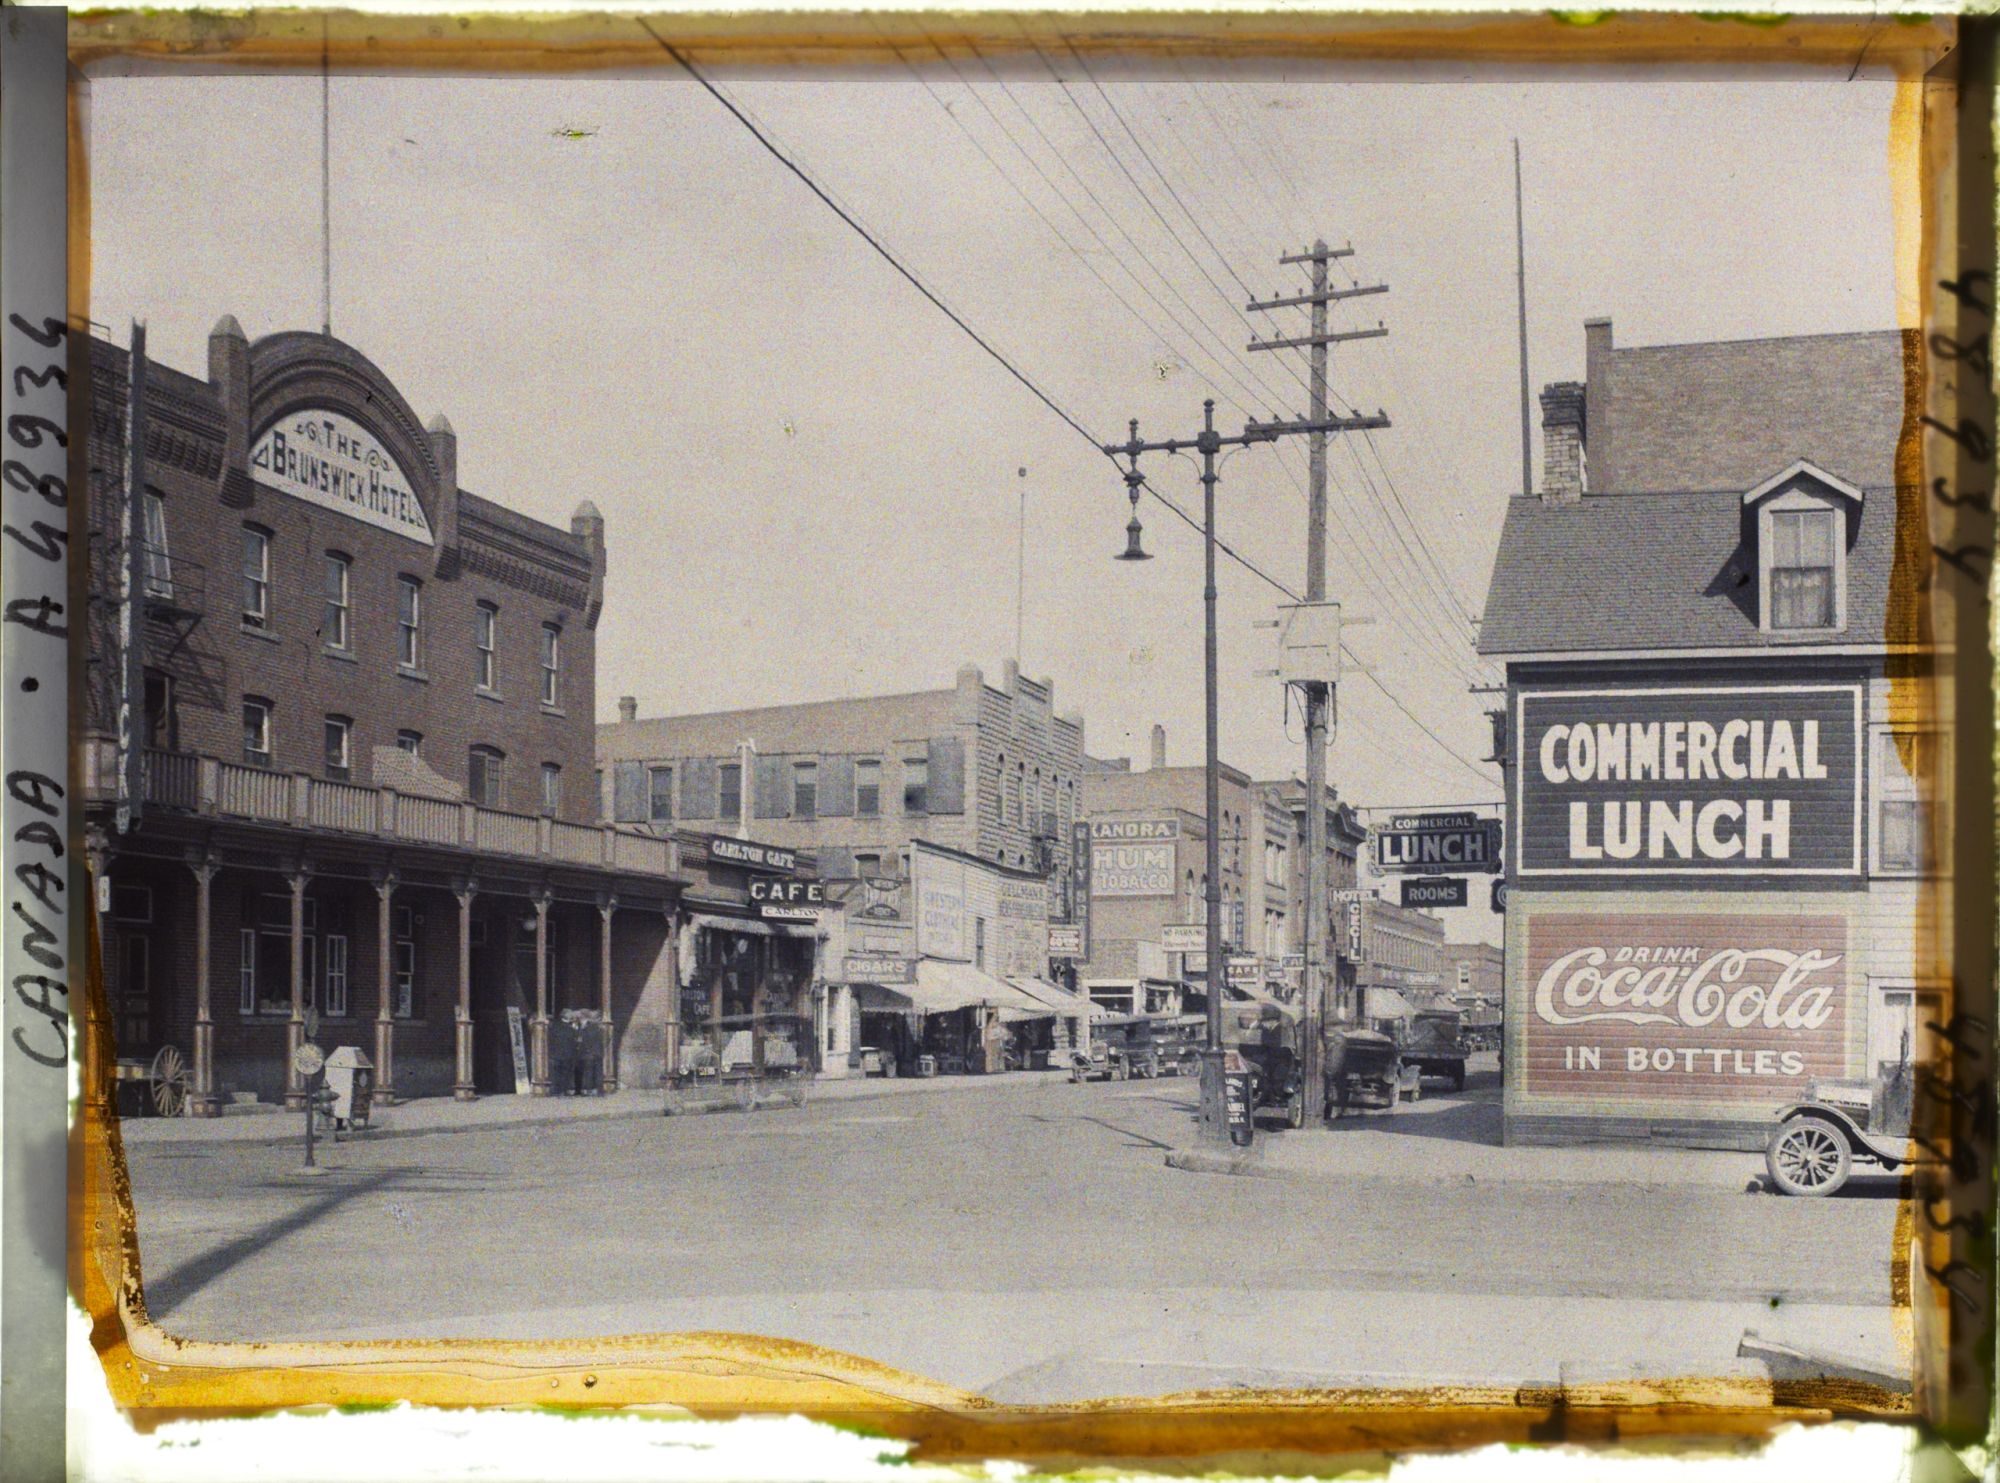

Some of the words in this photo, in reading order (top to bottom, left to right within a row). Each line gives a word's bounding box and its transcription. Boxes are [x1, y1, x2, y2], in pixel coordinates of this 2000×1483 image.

[323, 419, 361, 461] THE
[273, 429, 365, 506] BRUNSWICK
[369, 469, 415, 525] HOTEL
[5, 596, 68, 638] A
[1540, 719, 1827, 784] COMMERCIAL
[1395, 817, 1470, 829] COMMERCIAL
[1569, 799, 1791, 859] LUNCH
[712, 840, 764, 863] CARLTON
[766, 848, 795, 869] CAFE
[1092, 849, 1168, 870] HUM
[1382, 833, 1484, 863] LUNCH
[750, 881, 824, 901] CAFE
[1101, 873, 1170, 889] TOBACCO
[1332, 890, 1375, 901] HOTEL
[1408, 887, 1458, 900] ROOMS
[6, 769, 68, 1068] CANADA
[1350, 903, 1361, 961] CECIL
[846, 960, 908, 974] CIGARS
[1613, 946, 1701, 963] DRINK
[1535, 946, 1845, 1029] Coca-Cola
[1565, 1046, 1601, 1070] IN
[1627, 1046, 1804, 1075] BOTTLES
